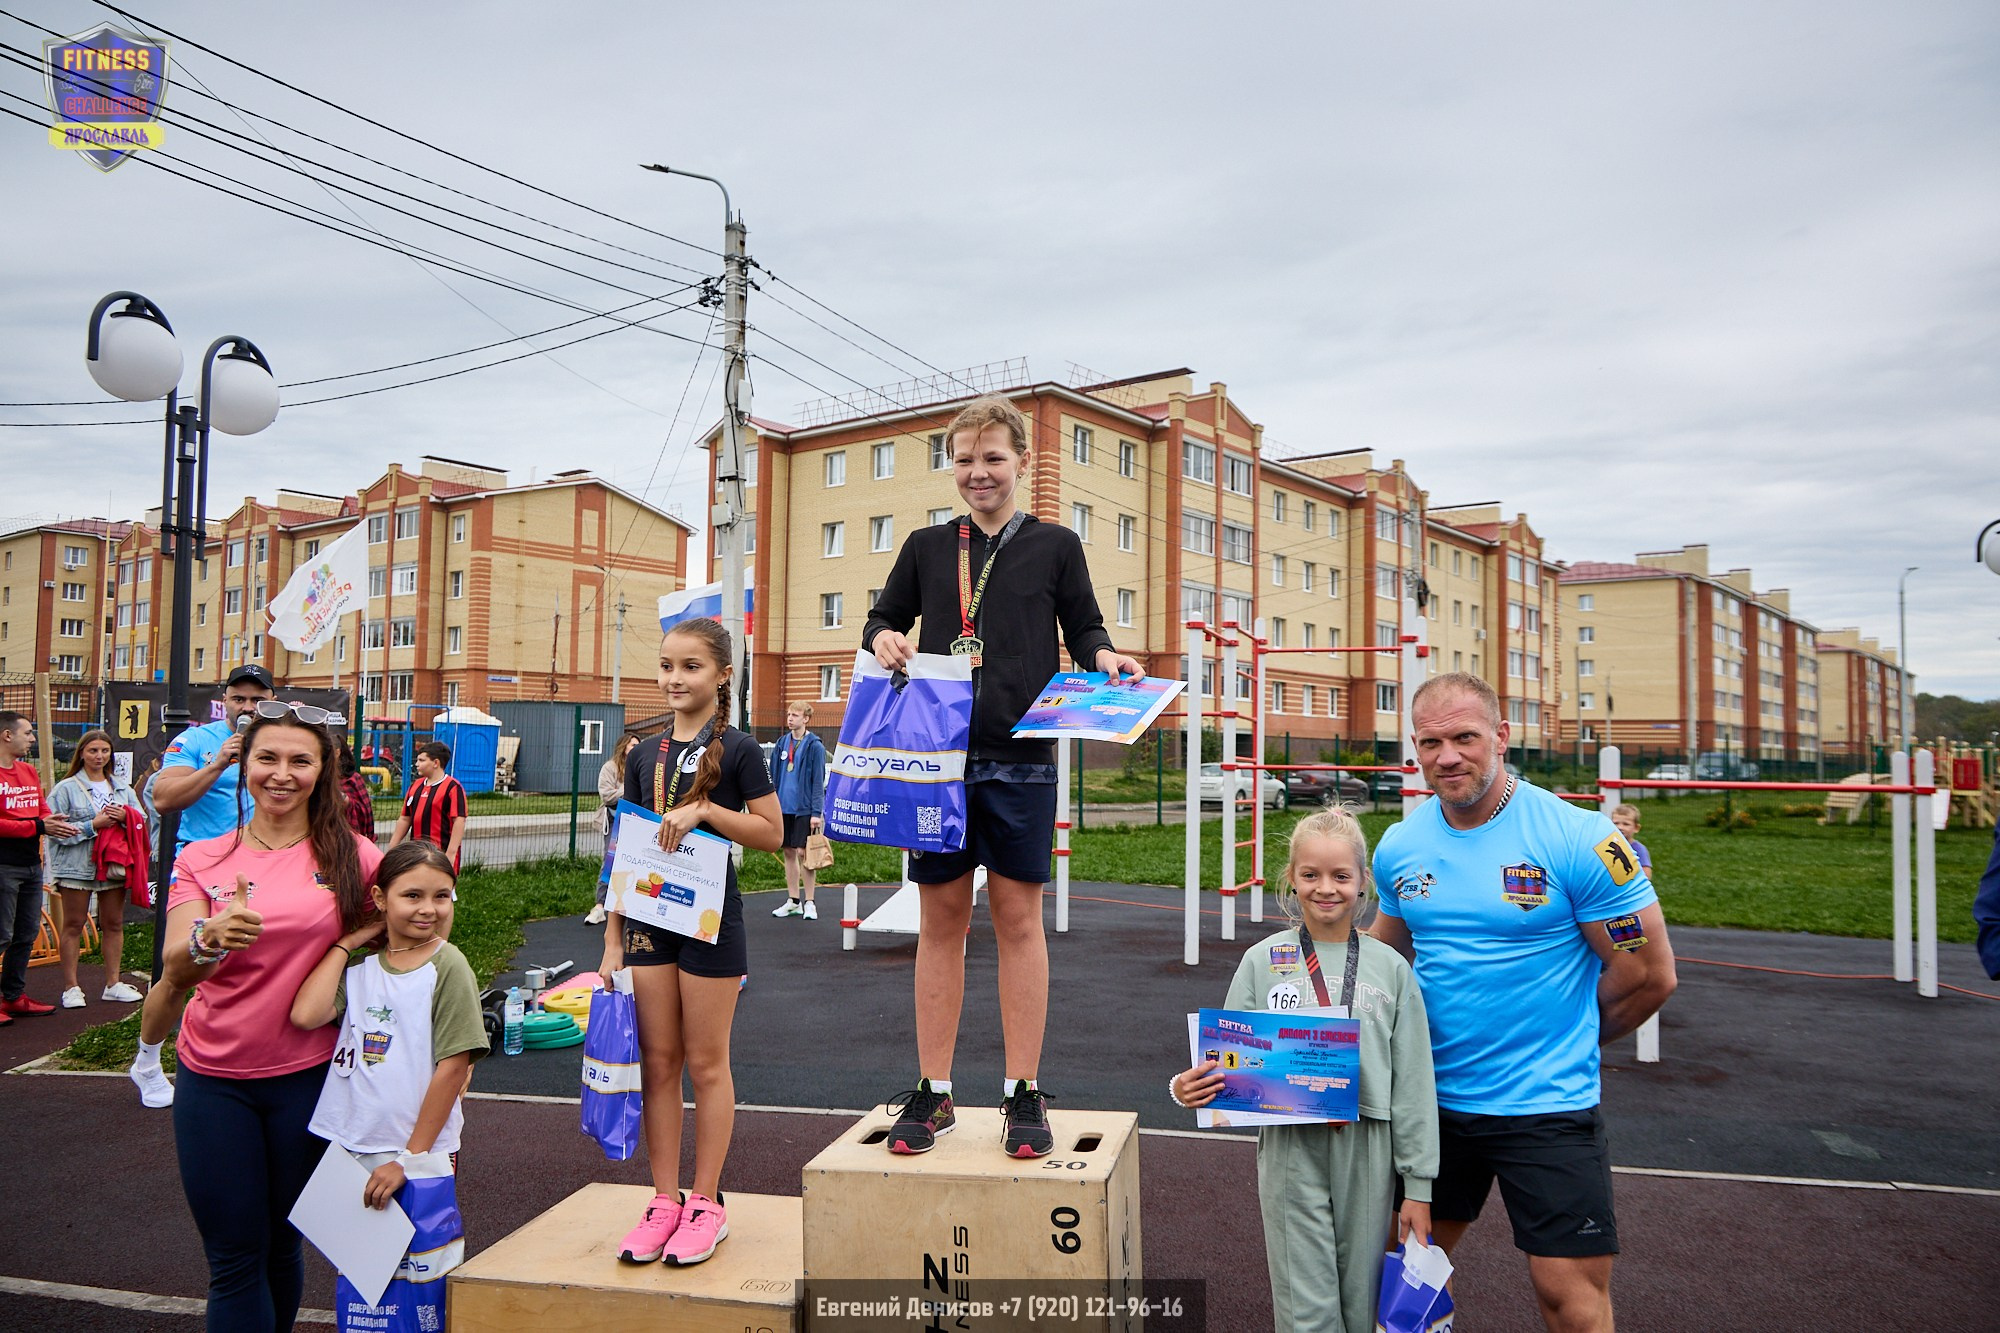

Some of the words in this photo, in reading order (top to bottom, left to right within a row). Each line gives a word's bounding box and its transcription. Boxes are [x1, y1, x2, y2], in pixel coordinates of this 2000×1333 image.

[832, 810, 837, 820] В
[838, 811, 878, 827] МОБИЛЬНОМ
[831, 823, 875, 839] ПРИЛОЖЕНИИ
[622, 854, 672, 873] ПОДАРОЧНЫЙ
[673, 869, 719, 889] СЕРТИФИКАТ
[1507, 868, 1542, 878] FITNESS
[1609, 918, 1636, 930] FITNESS
[1272, 992, 1298, 1009] 166
[365, 1034, 388, 1042] FITNESS
[334, 1047, 355, 1068] 41
[1042, 1160, 1088, 1171] 50
[1050, 1206, 1082, 1254] 60
